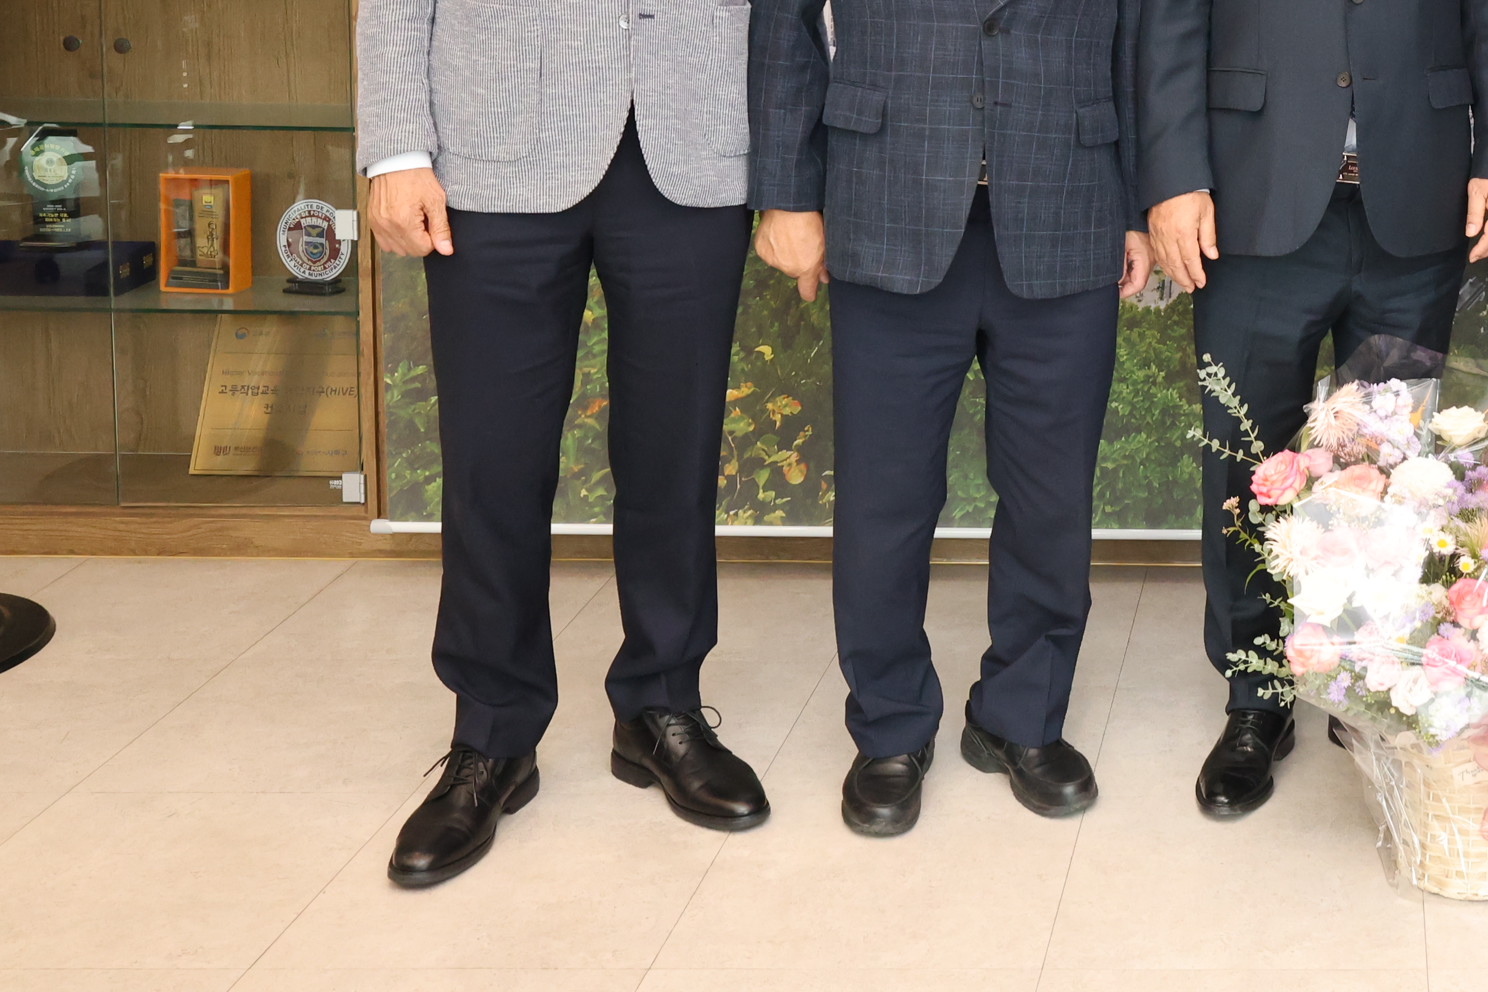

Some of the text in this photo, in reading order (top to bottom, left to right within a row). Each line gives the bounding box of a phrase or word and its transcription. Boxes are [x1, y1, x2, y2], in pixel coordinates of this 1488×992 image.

[282, 244, 345, 278] PORT VILA MUNICIPALITY
